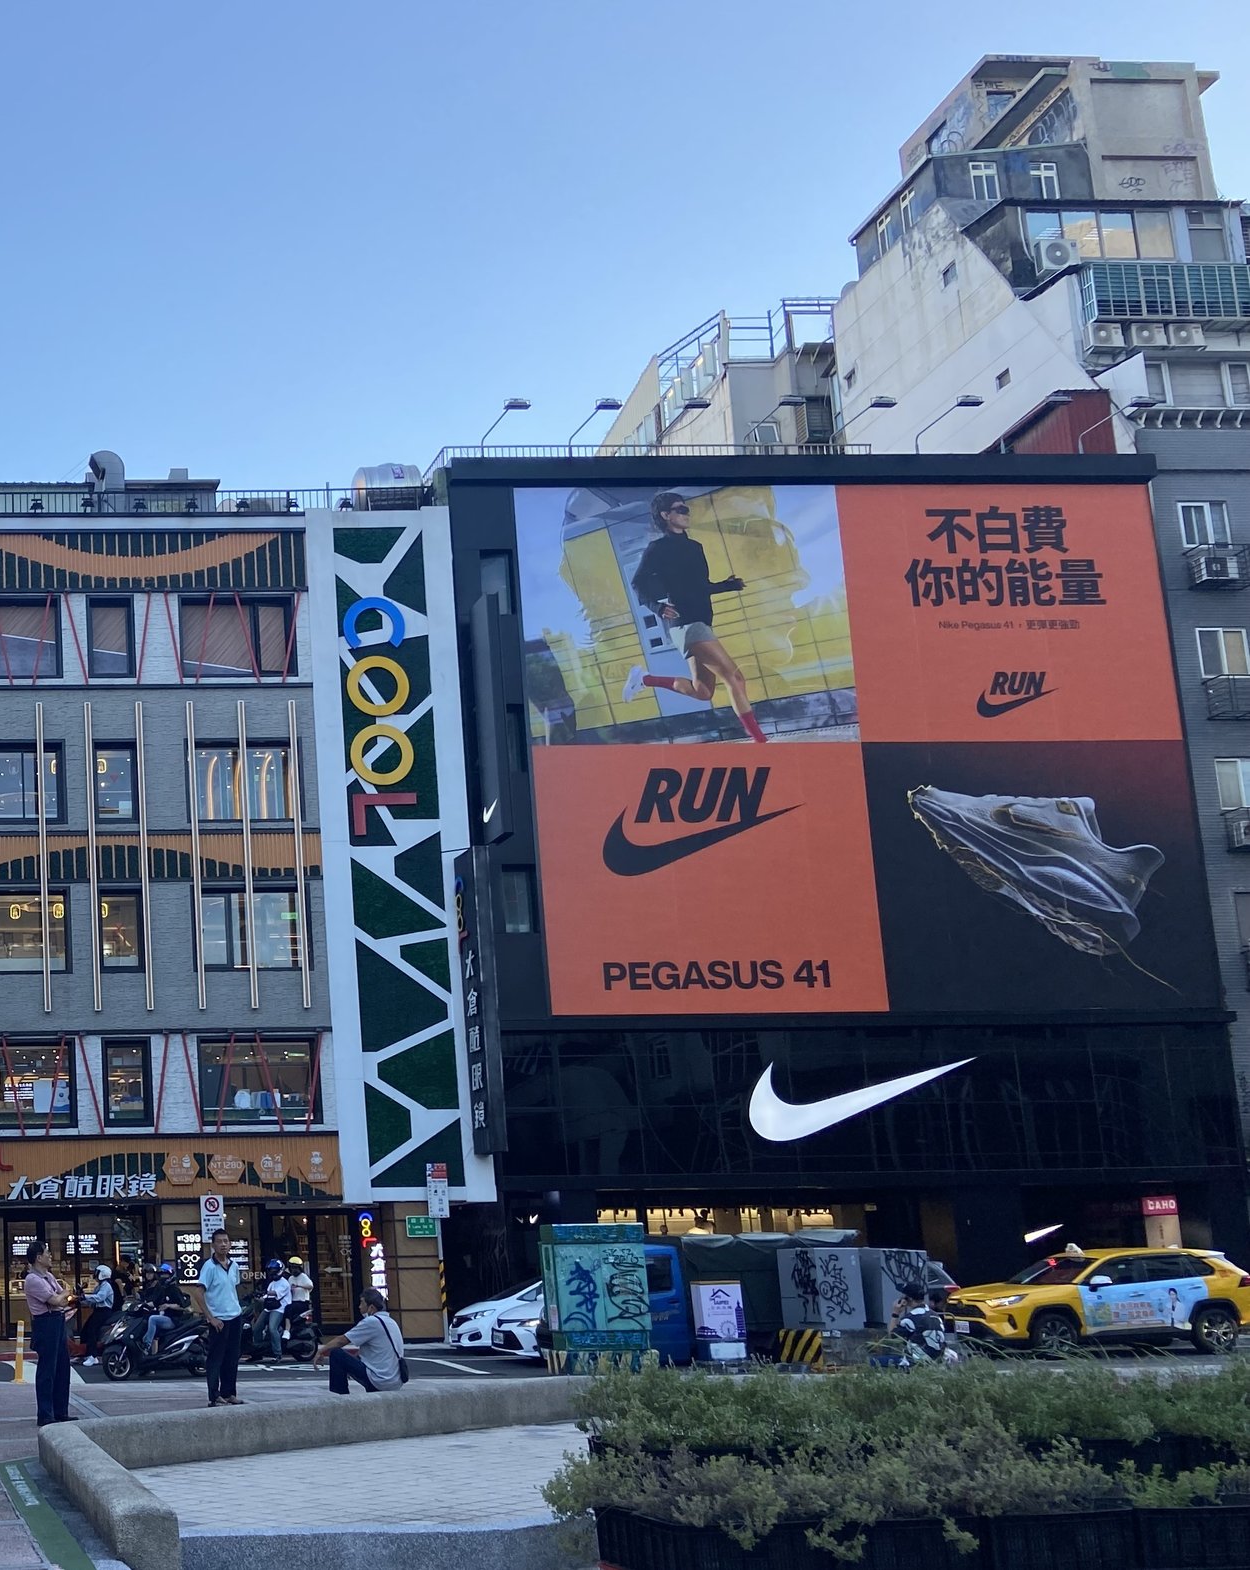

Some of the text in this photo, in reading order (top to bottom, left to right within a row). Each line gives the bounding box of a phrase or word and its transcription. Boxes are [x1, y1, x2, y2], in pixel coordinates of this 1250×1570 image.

[925, 505, 1070, 554] 不白費
[904, 557, 1107, 608] 你的能量
[938, 620, 959, 630] Nike
[961, 620, 1002, 632] Pegasus
[989, 671, 1047, 696] RUN
[343, 596, 417, 836] COOL
[634, 766, 771, 824] RUN
[602, 959, 832, 990] PEGASUS 41
[465, 949, 486, 1129] 大倉酷眼鏡
[7, 1172, 158, 1200] 大倉酷眼鏡
[183, 1233, 202, 1243] 399
[241, 1271, 267, 1280] OPEN
